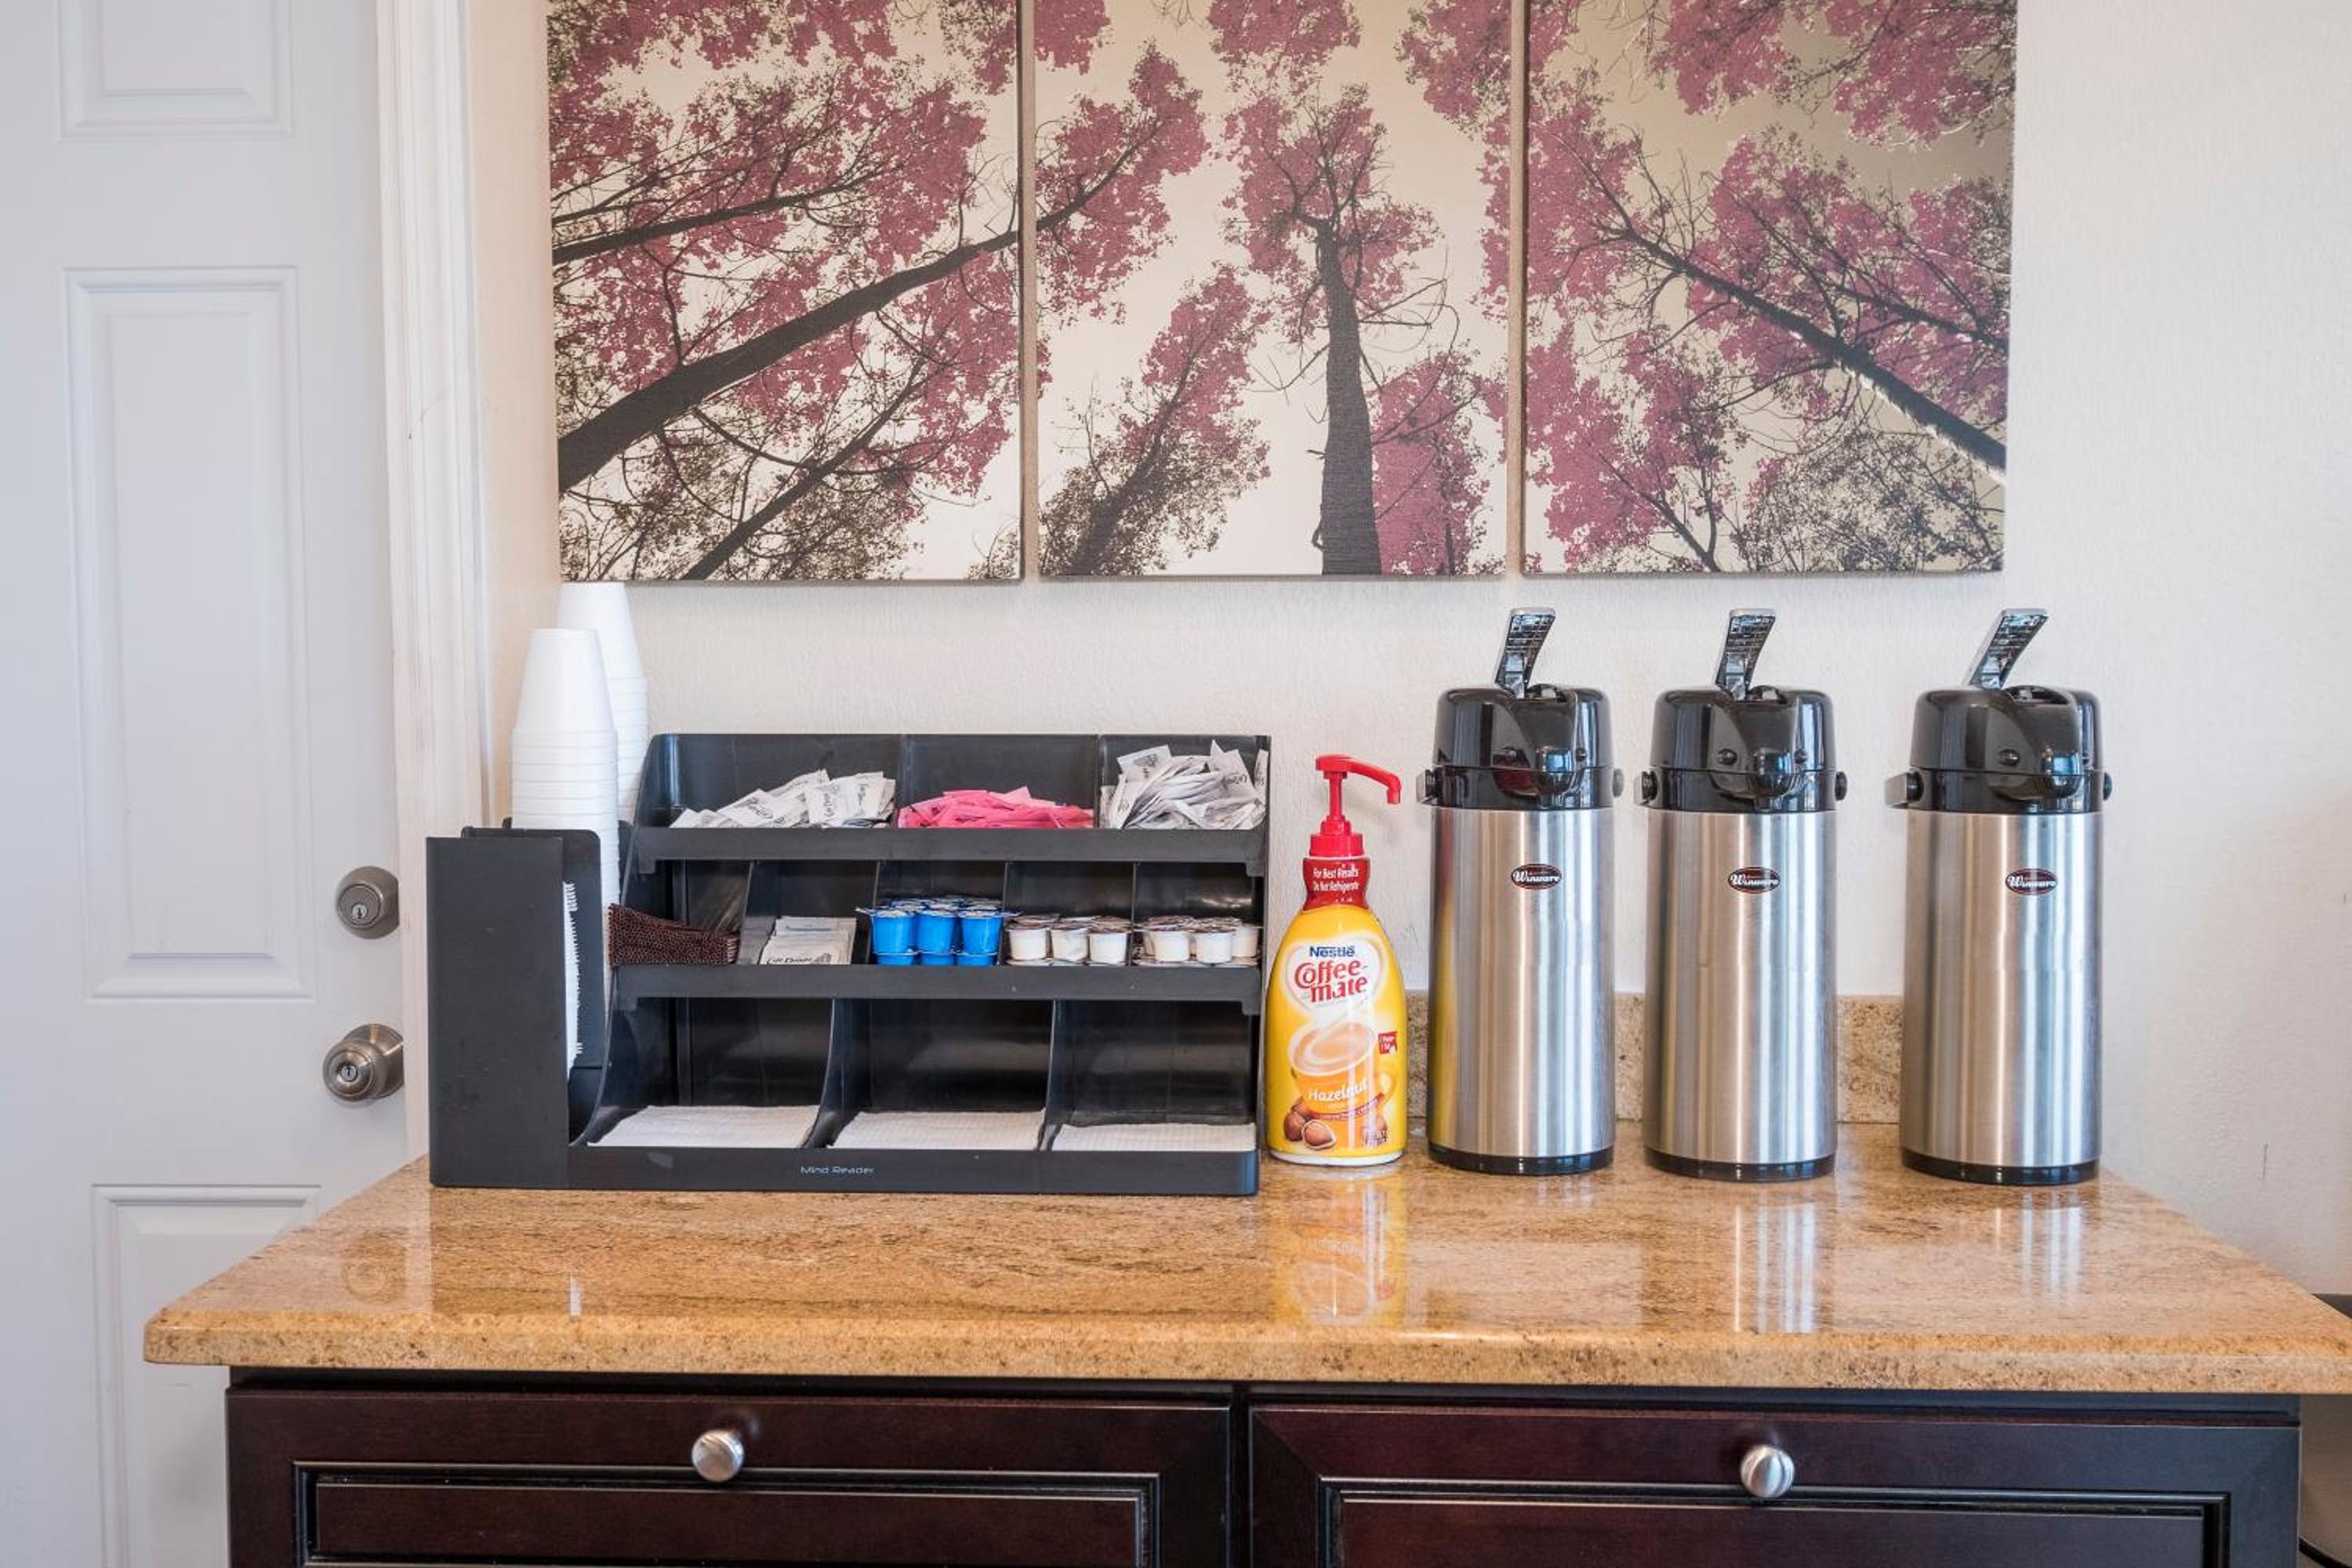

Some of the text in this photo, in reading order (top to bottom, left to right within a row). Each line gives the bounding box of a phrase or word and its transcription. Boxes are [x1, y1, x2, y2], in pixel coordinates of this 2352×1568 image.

[1310, 976, 1367, 1003] mate
[800, 1166, 875, 1174] Mind Reader
